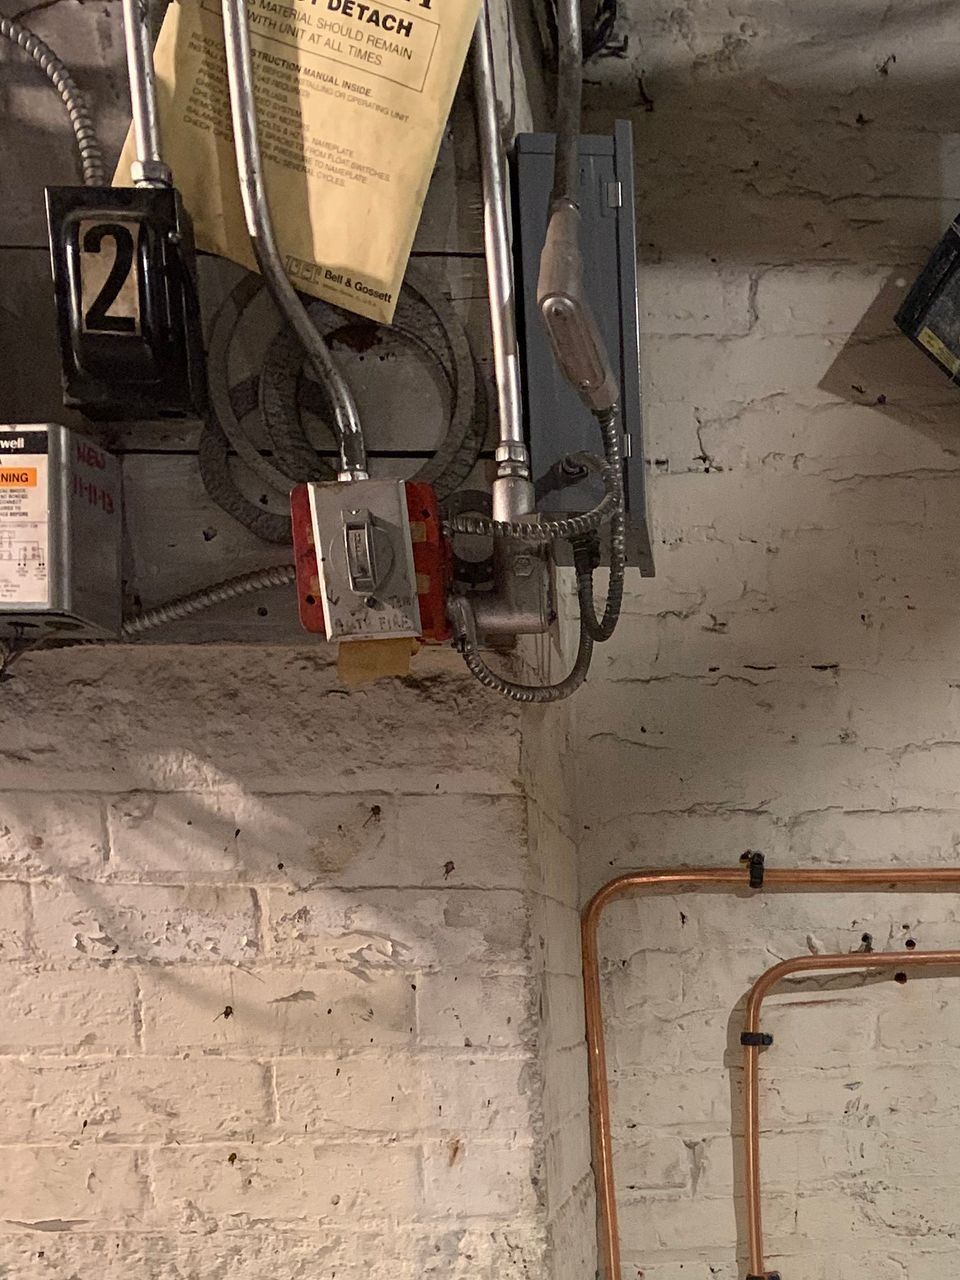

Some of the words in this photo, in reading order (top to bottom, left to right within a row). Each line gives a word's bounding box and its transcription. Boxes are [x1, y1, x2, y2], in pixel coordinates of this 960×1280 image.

[259, 1, 313, 26] MATERIAL
[316, 17, 364, 42] SHOULD
[366, 34, 413, 60] REMAIN
[327, 0, 413, 37] DETACH
[247, 10, 277, 30] WITH
[279, 22, 307, 39] UNIT
[308, 32, 322, 45] AT
[324, 38, 343, 53] ALL
[348, 44, 383, 66] TIMES
[250, 48, 301, 73] STRUCTION
[303, 67, 339, 86] MANUAL
[84, 224, 136, 332] 2
[324, 269, 344, 284] Bell
[345, 277, 353, 288] &
[354, 281, 392, 303] Gossett
[0, 437, 25, 449] well
[0, 472, 29, 483] NING
